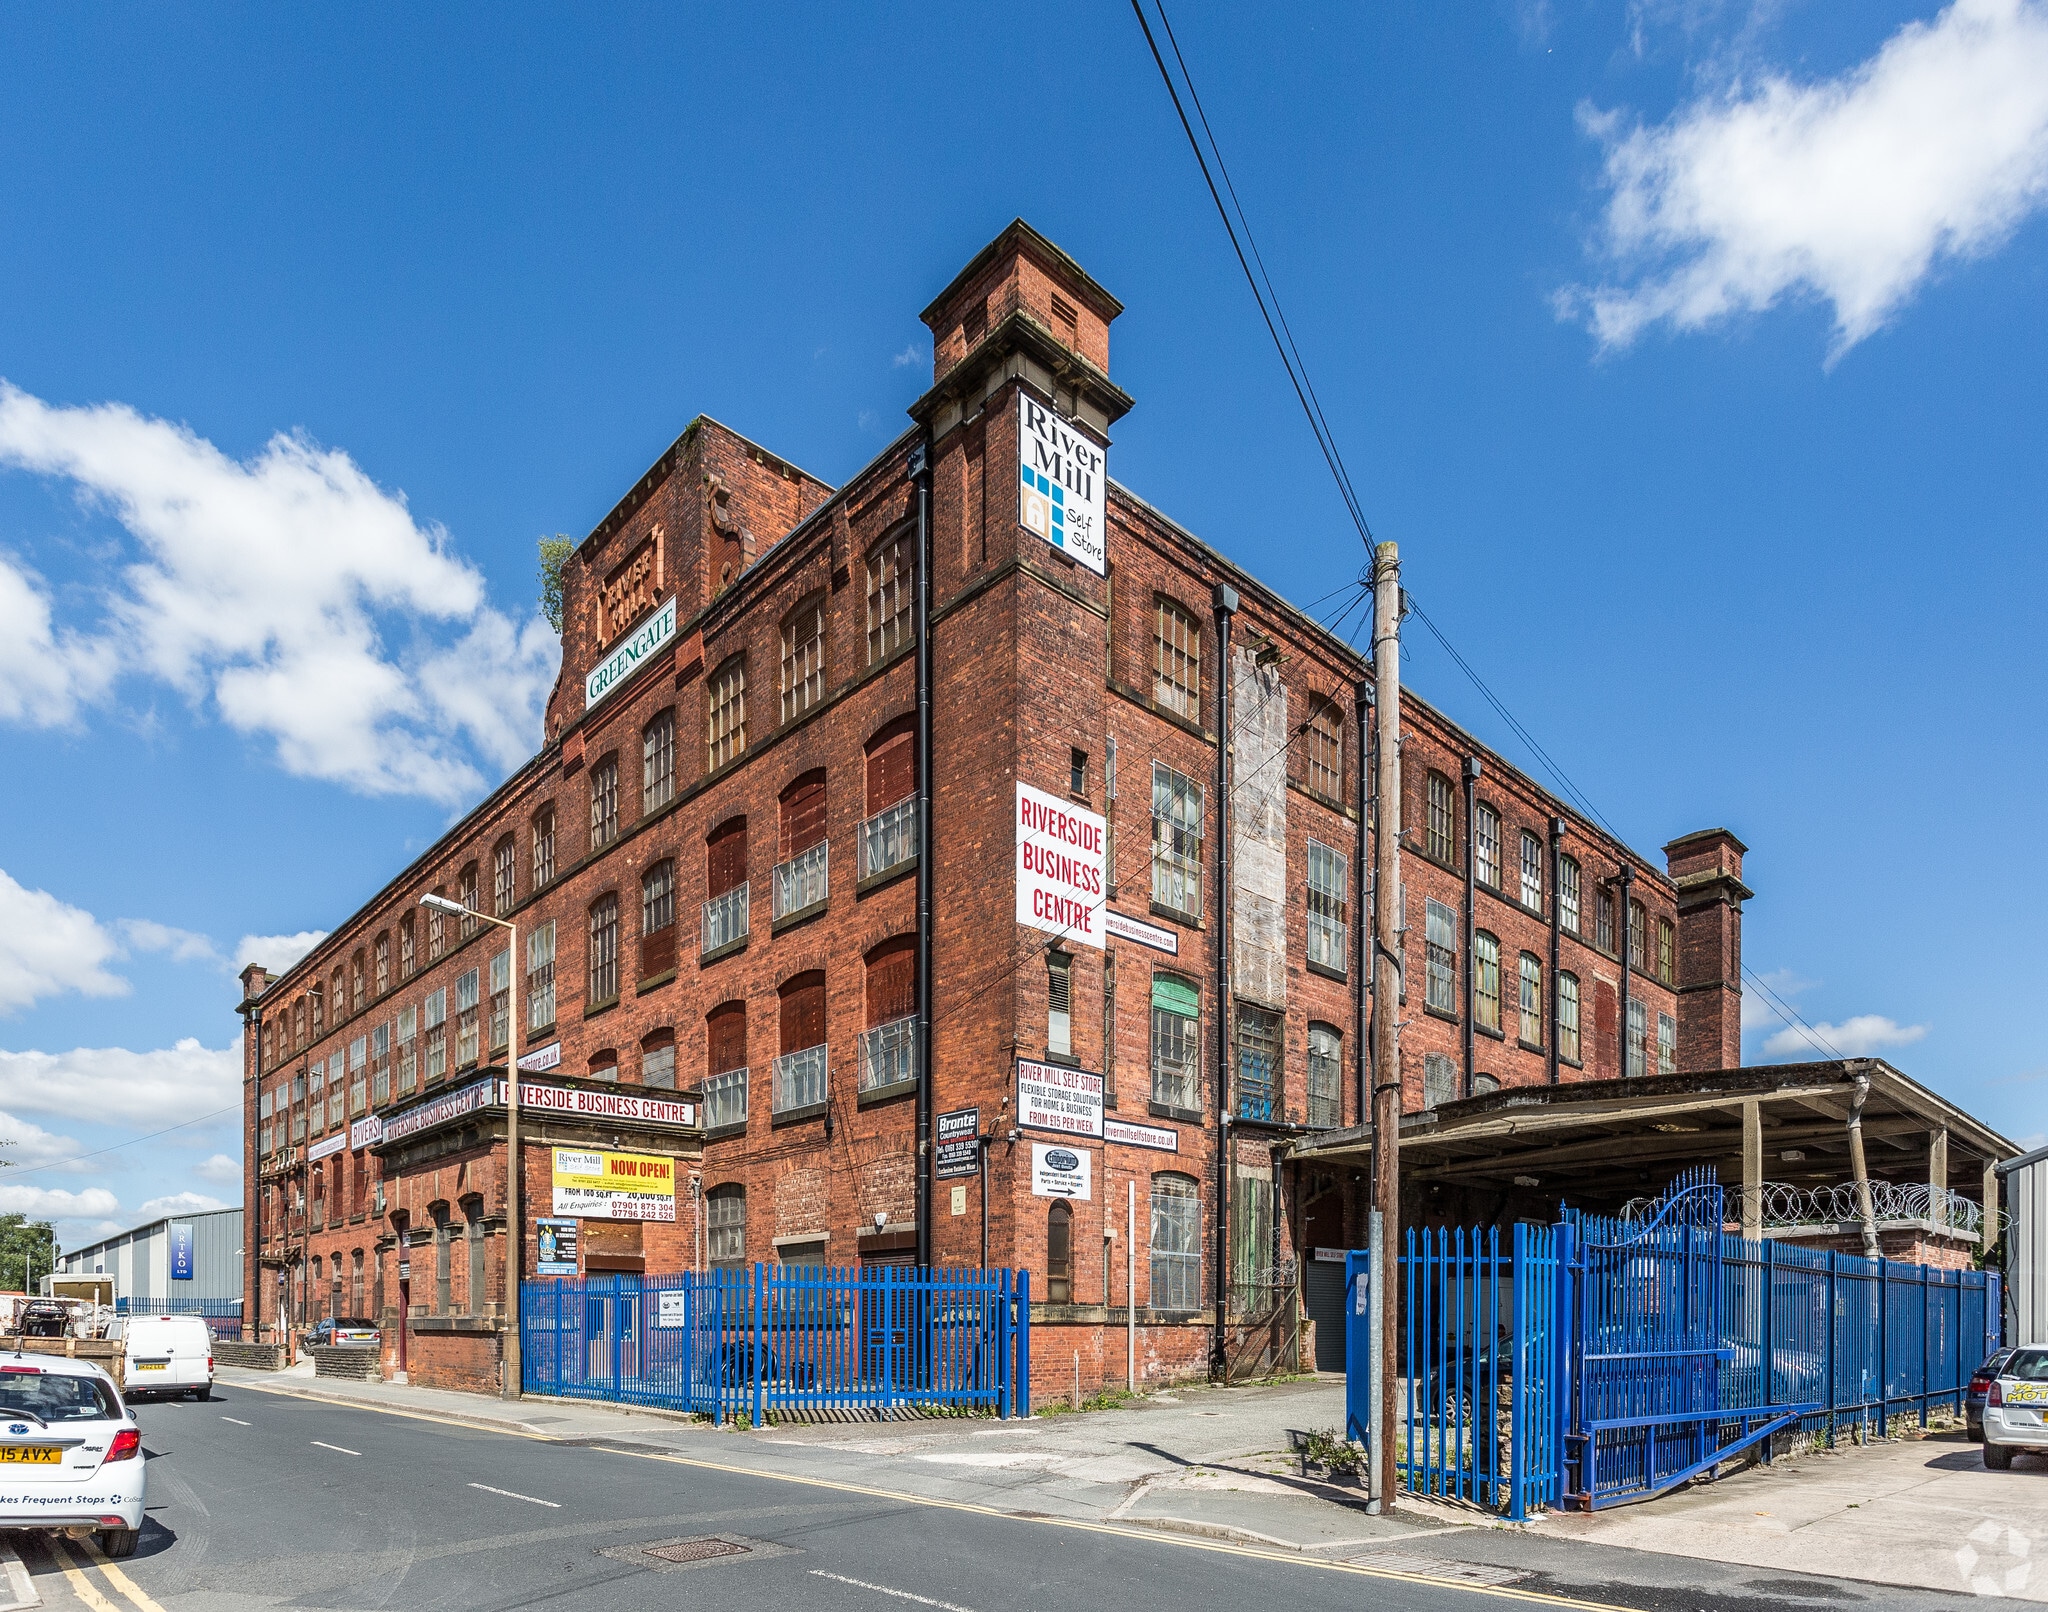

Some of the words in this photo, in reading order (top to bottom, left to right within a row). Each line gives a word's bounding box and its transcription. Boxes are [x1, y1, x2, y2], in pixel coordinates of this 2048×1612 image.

[1024, 397, 1102, 475] River
[1032, 436, 1092, 503] Mill
[1066, 508, 1092, 539] Self
[1071, 532, 1102, 561] Store
[608, 551, 651, 611] RIVER
[589, 608, 674, 699] GREENGATE
[1021, 797, 1102, 855] RIVERSIDE
[1023, 841, 1100, 896] BUSINESS
[1033, 888, 1092, 934] CENTRE
[1020, 1063, 1042, 1082] RIVER
[1044, 1067, 1061, 1086] MILL
[1063, 1071, 1079, 1089] SELF
[1081, 1075, 1101, 1094] STORE
[505, 1083, 573, 1109] RVERSIDE
[578, 1092, 638, 1117] BUSINESS
[642, 1102, 686, 1122] CENTRE
[1021, 1083, 1046, 1097] FLEXIBLE
[1048, 1088, 1071, 1102] STORAGE
[1073, 1093, 1101, 1107] SOLUTIONS
[1031, 1097, 1042, 1108] FOR
[1043, 1099, 1059, 1111] HOME
[1060, 1102, 1065, 1112] &
[1066, 1103, 1092, 1117] BUSINESS
[387, 1109, 419, 1141] RIVERSIDE
[420, 1099, 454, 1129] BUSINESS
[455, 1082, 485, 1114] CENTRE
[939, 1114, 976, 1133] Bronte
[1029, 1111, 1048, 1126] FROM
[1049, 1115, 1060, 1128] £15
[1063, 1117, 1074, 1129] PER
[1076, 1119, 1094, 1133] WEEK
[940, 1128, 973, 1140] Countrywear
[1105, 1124, 1174, 1146] rivermillselfstore.co.uk
[558, 1153, 582, 1163] River
[584, 1155, 601, 1165] Mill
[611, 1159, 637, 1176] NOW
[640, 1161, 670, 1179] OPEN!
[565, 1188, 581, 1196] FROM
[557, 1202, 568, 1210] All
[570, 1200, 603, 1211] Enquiries
[611, 1201, 638, 1210] 07901
[641, 1202, 656, 1210] 875
[658, 1203, 674, 1211] 304
[611, 1209, 638, 1218] 07796
[641, 1210, 656, 1219] 242
[658, 1211, 674, 1219] 526
[177, 1226, 186, 1268] ARTKO
[1, 1448, 16, 1461] 15
[21, 1448, 53, 1461] AVX
[22, 1495, 73, 1505] Frequent
[76, 1495, 105, 1505] Stops
